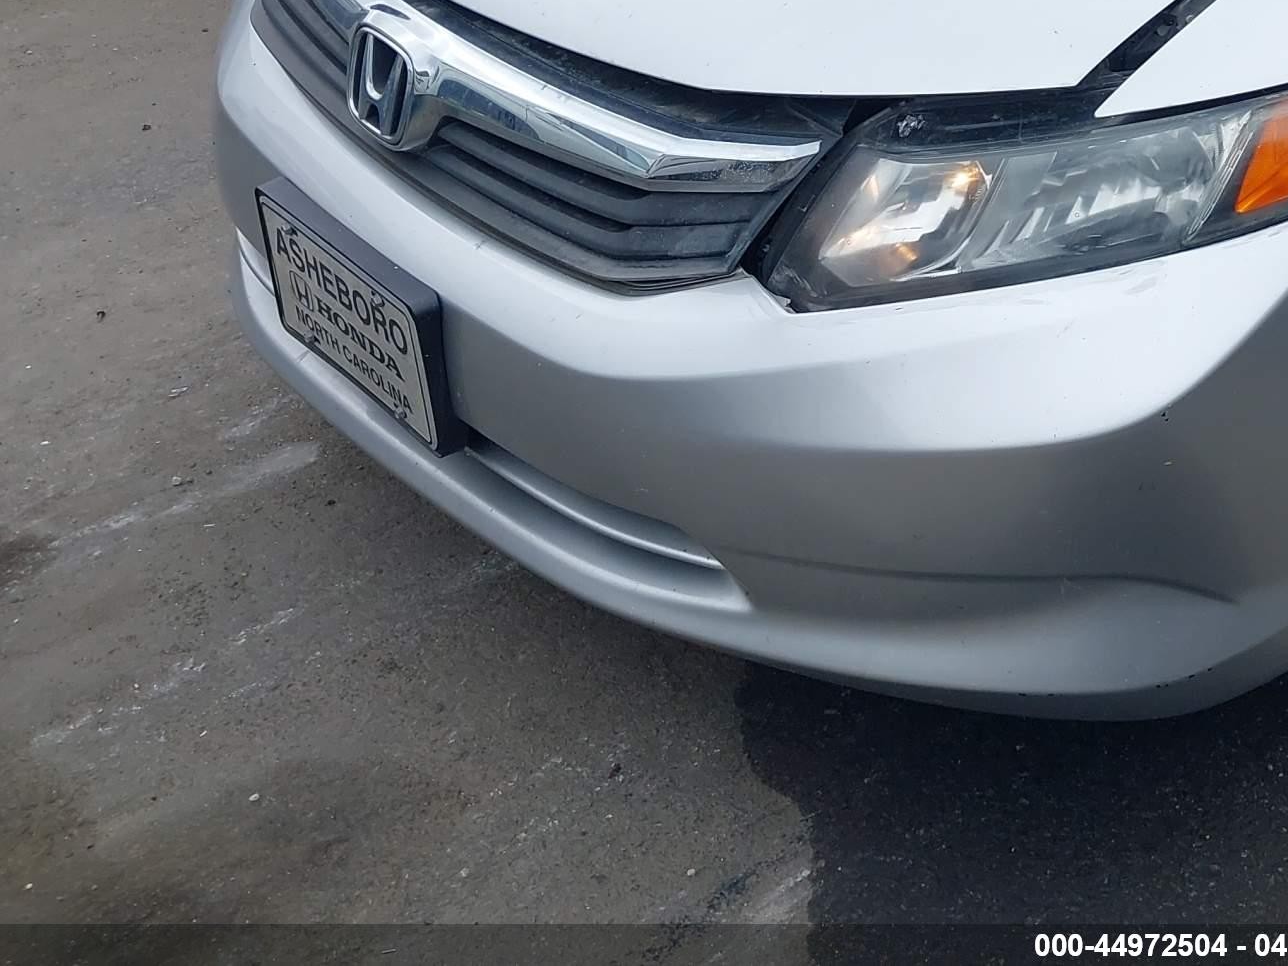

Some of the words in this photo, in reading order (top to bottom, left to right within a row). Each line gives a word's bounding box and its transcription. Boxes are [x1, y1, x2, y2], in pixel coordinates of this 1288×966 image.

[276, 227, 408, 355] ASHEBORO
[313, 294, 406, 383] HONDA
[295, 304, 341, 355] NORTH
[342, 345, 413, 414] CAROLINA
